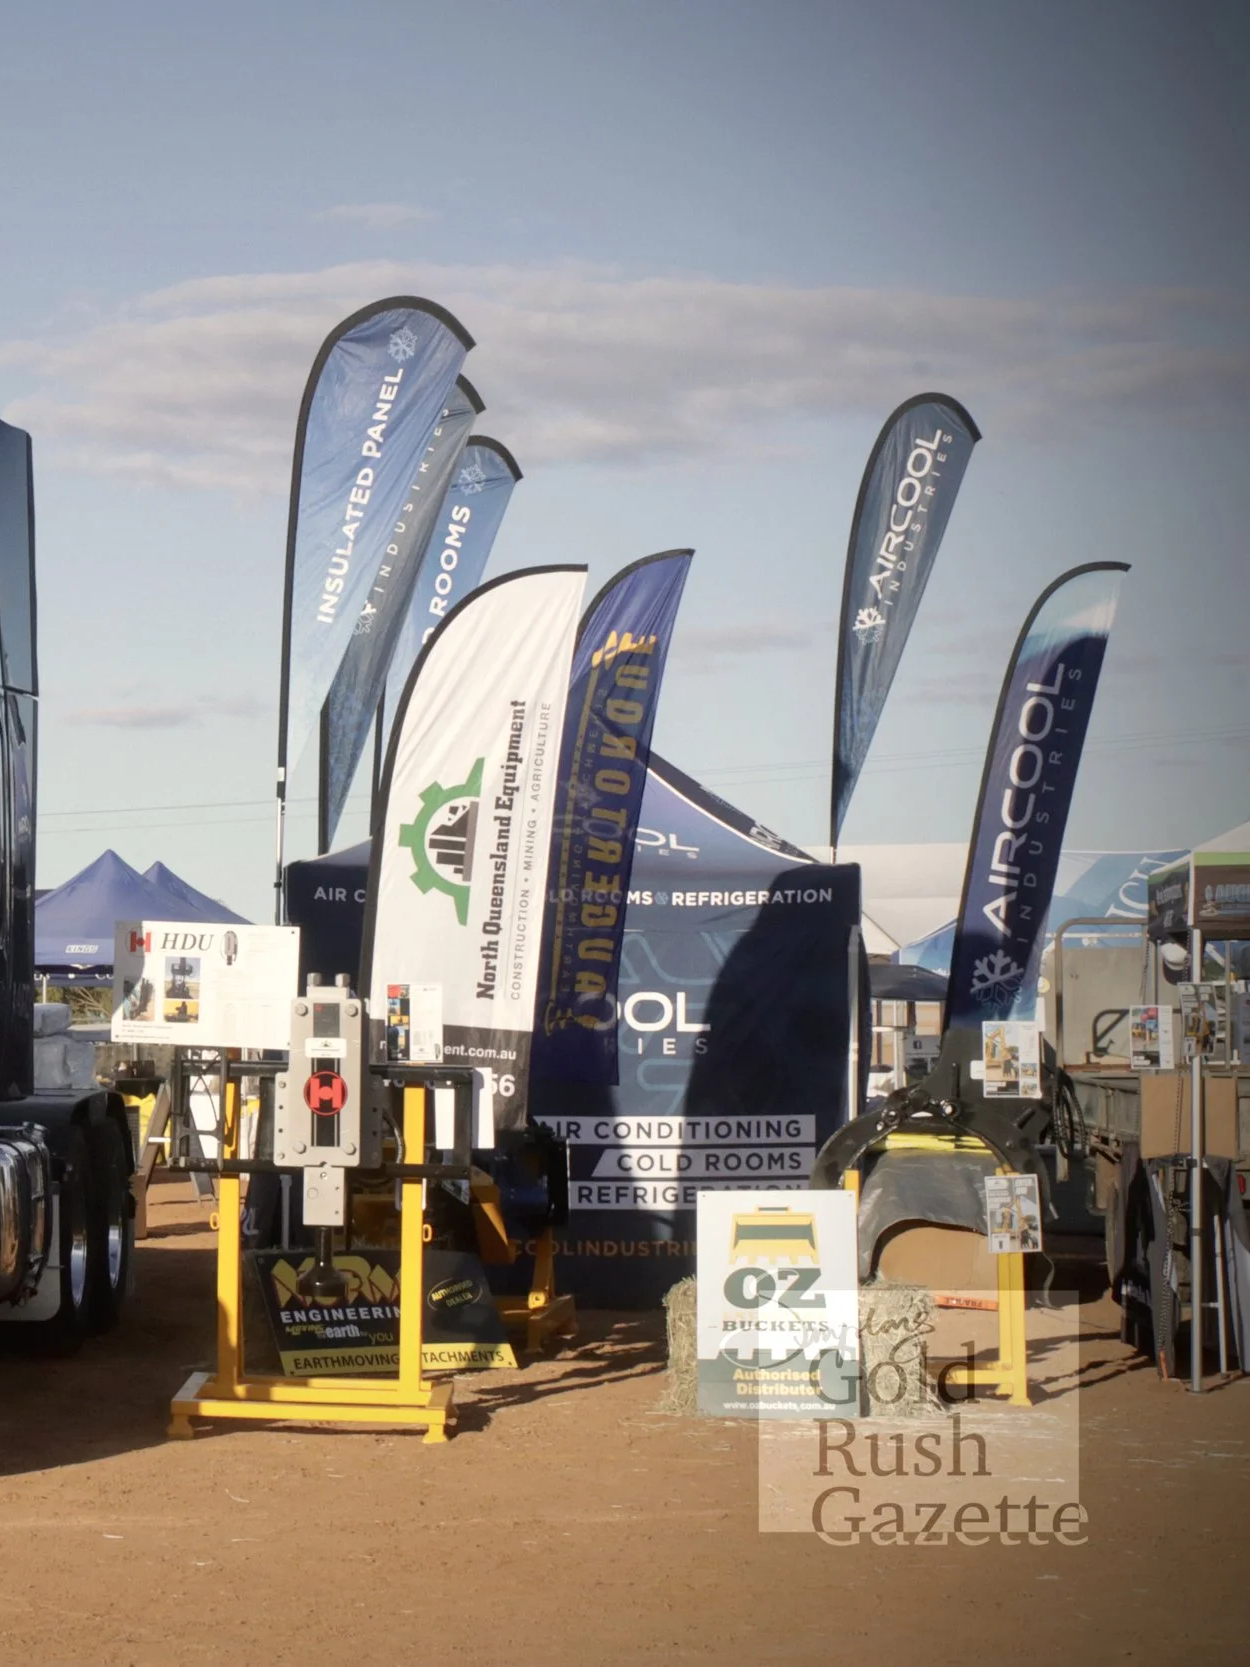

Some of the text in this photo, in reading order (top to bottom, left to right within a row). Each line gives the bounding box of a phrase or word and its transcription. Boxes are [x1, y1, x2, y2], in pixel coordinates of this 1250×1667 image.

[317, 369, 403, 623] INSULATED PANEL
[866, 429, 942, 599] AIRCOOL
[884, 432, 953, 606] INDUSTRIES
[428, 505, 471, 616] ROOMS
[981, 662, 1064, 936] AIRCOOL
[1018, 667, 1082, 943] INDUSTRIES
[476, 700, 527, 1000] North Queensland Equipment
[511, 703, 551, 1000] CONSTRUCTION MINING AGRICULTURE
[314, 886, 347, 901] AIR
[671, 887, 832, 907] REFRIGERATION
[160, 932, 215, 951] HDU
[594, 1119, 802, 1139] CONDITIONING
[617, 1151, 802, 1172] COLD ROOMS
[578, 1184, 802, 1204] REFRIGE
[723, 1266, 827, 1310] OZ
[326, 1324, 360, 1339] earth
[368, 1332, 394, 1345] you
[722, 1320, 830, 1332] BUCKETS
[733, 1368, 821, 1381] Authorised
[736, 1382, 823, 1396] Distributor
